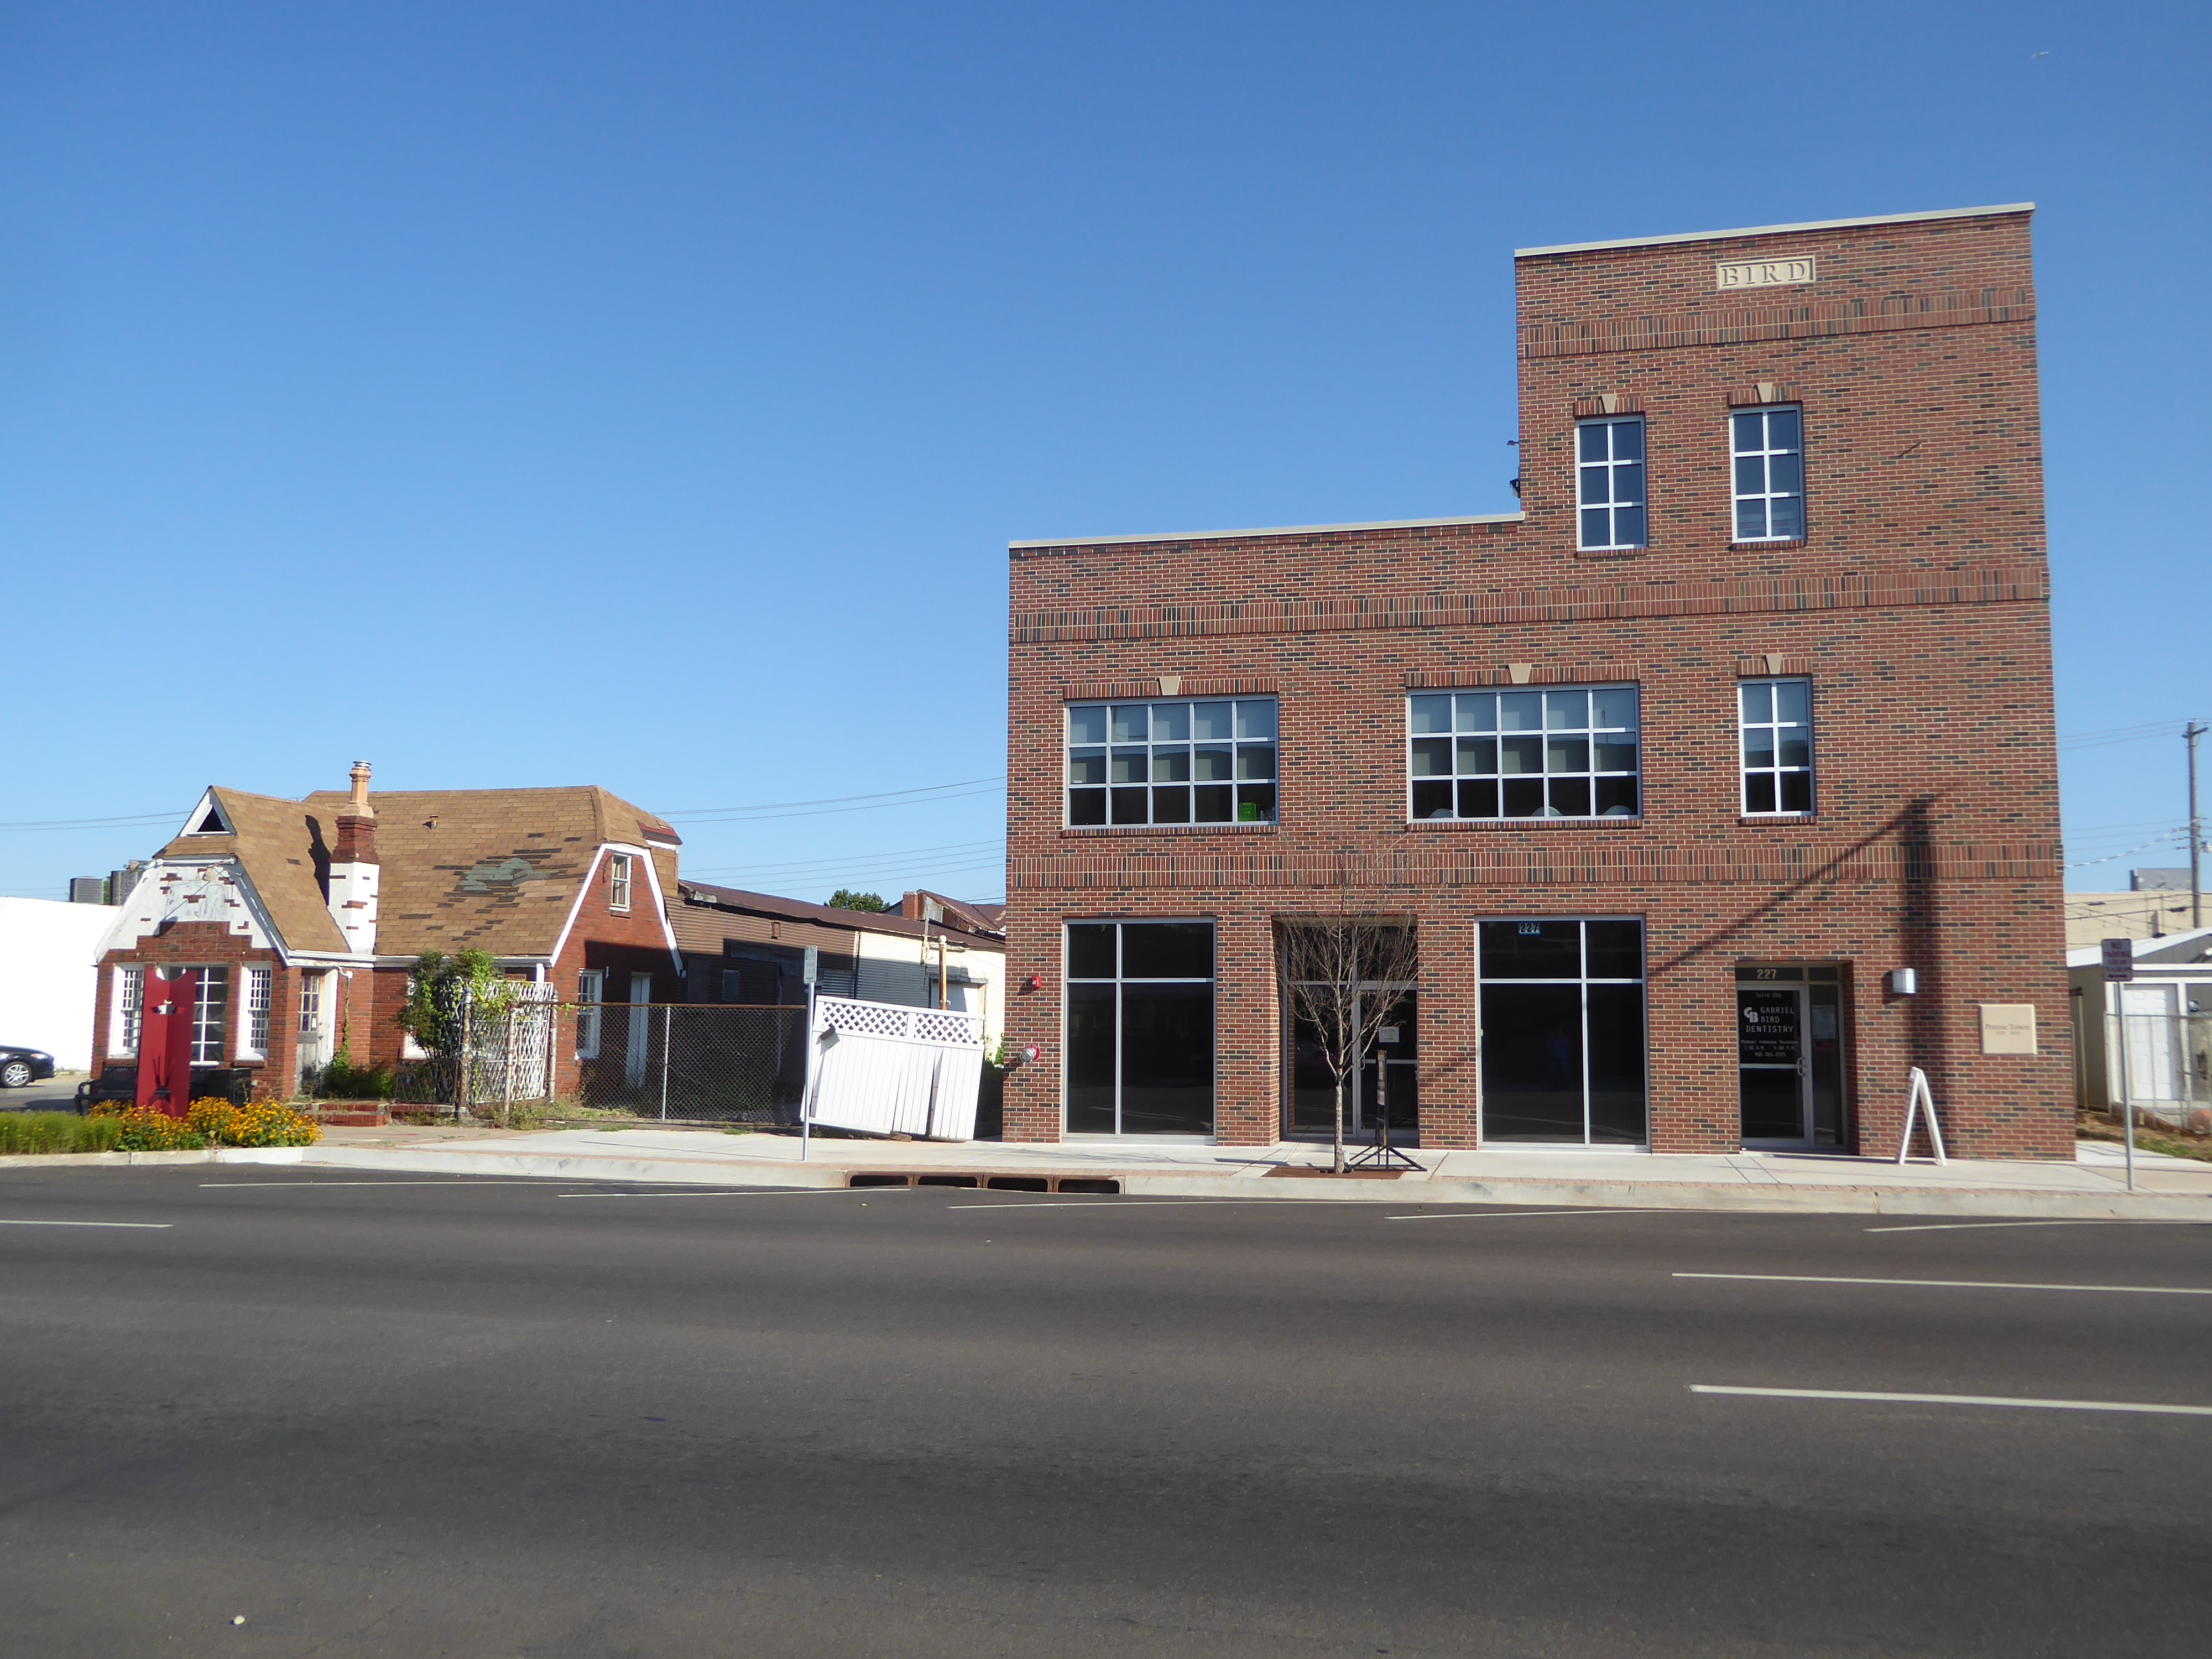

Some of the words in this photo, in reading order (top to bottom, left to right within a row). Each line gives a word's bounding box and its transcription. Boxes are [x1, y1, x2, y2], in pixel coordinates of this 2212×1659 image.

[1722, 263, 1806, 286] BIRD
[1520, 922, 1538, 932] 227
[1756, 969, 1776, 979] 227
